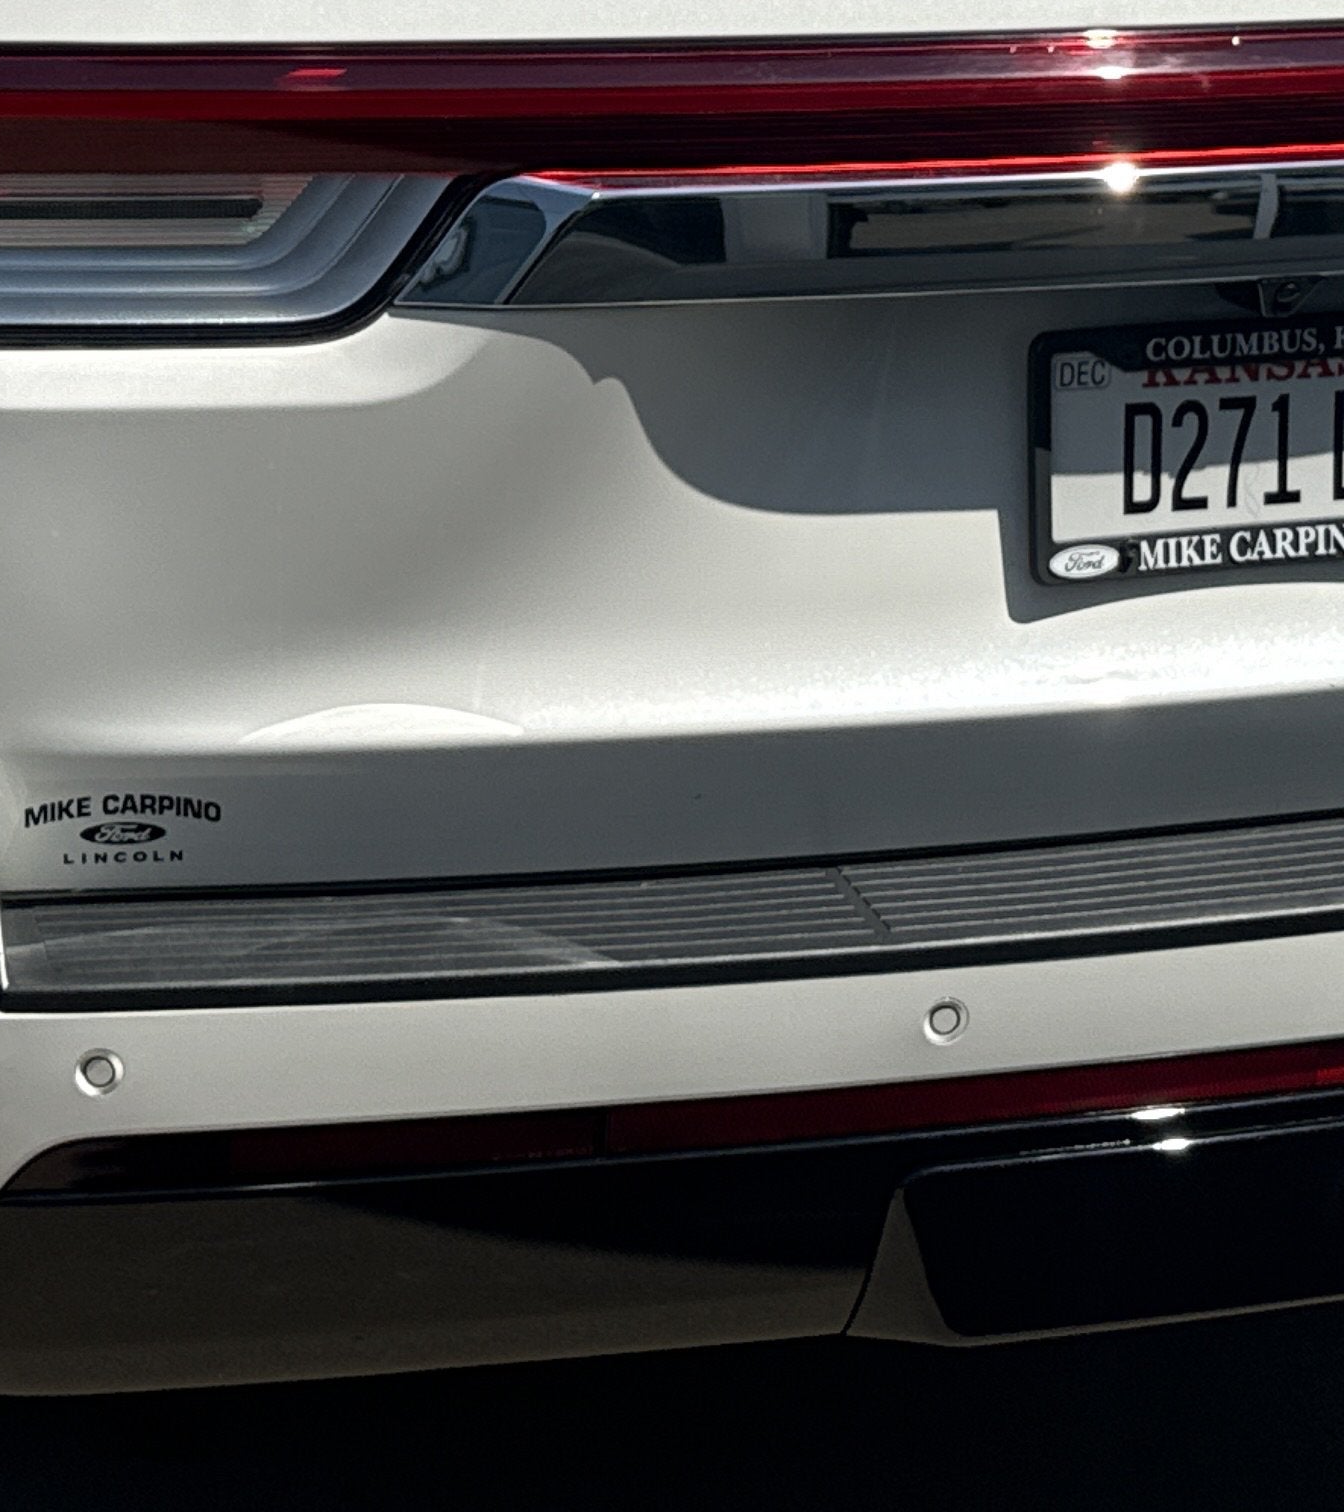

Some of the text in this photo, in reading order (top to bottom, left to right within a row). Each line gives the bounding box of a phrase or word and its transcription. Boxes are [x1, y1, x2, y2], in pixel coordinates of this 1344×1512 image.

[1146, 328, 1325, 362] COLUMBUS,
[1060, 360, 1106, 387] DEC
[1123, 393, 1301, 515] D271
[1064, 550, 1105, 573] Ford
[1138, 533, 1223, 572] MIKE
[24, 794, 222, 828] MIKE CARPINO
[93, 822, 153, 843] Ford
[63, 849, 184, 865] LINCOLN
